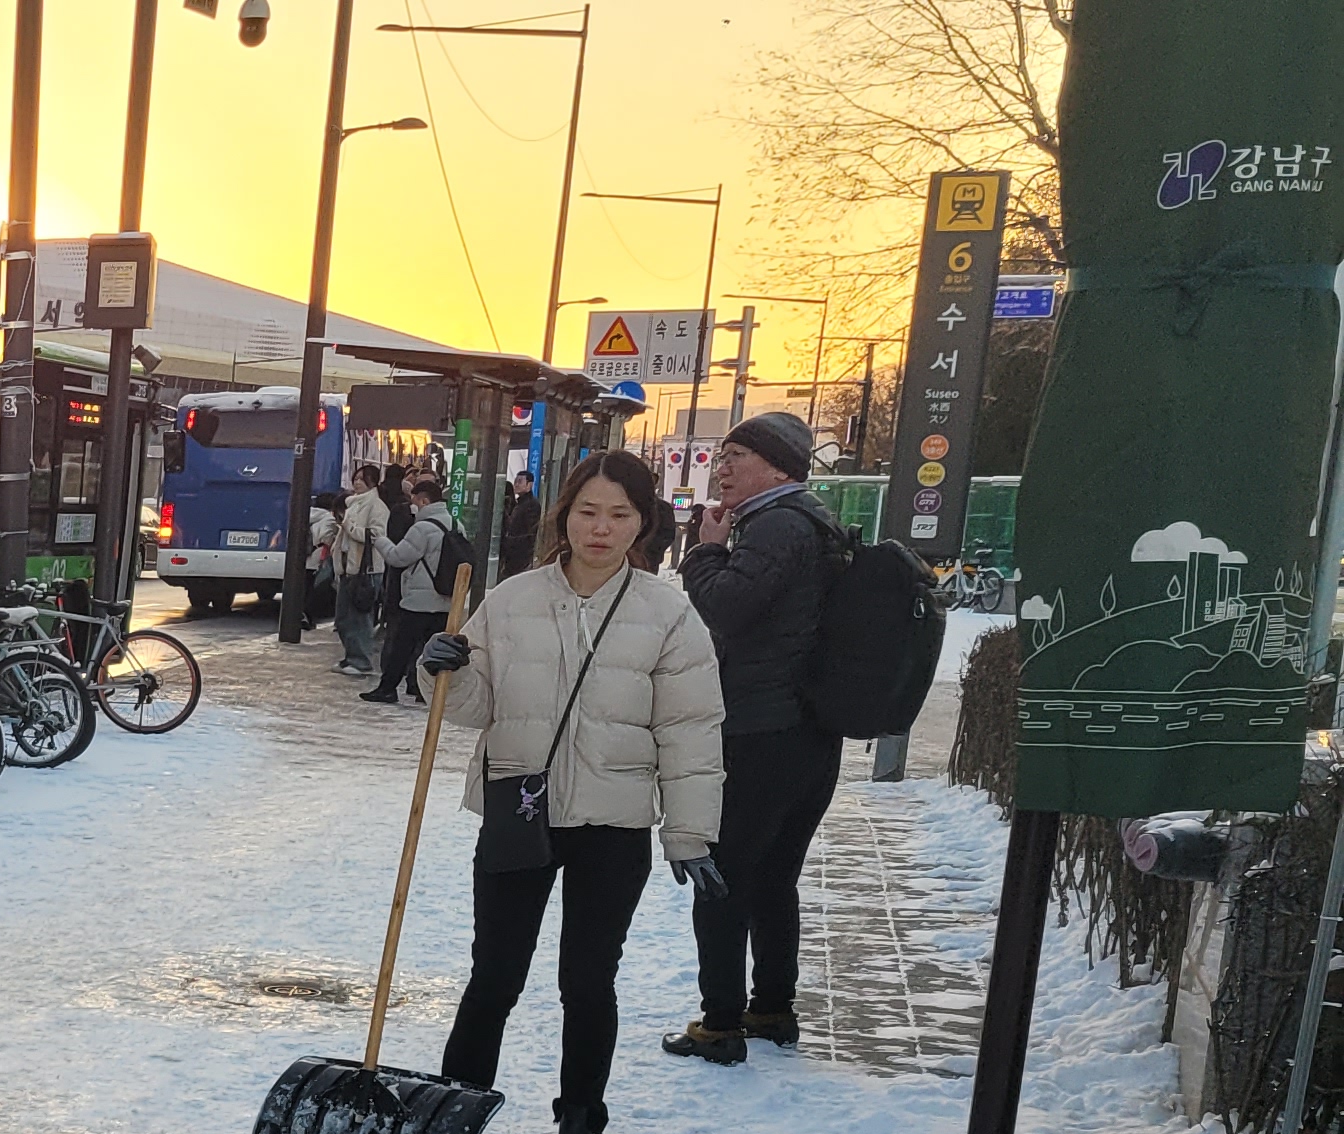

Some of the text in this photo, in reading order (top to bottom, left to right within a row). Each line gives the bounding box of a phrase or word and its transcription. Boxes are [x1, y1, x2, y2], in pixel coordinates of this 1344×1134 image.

[1226, 144, 1333, 180] 강남구
[1230, 180, 1274, 193] GANG
[947, 241, 973, 273] 6
[924, 388, 960, 399] Suseo
[928, 402, 951, 412] 水西
